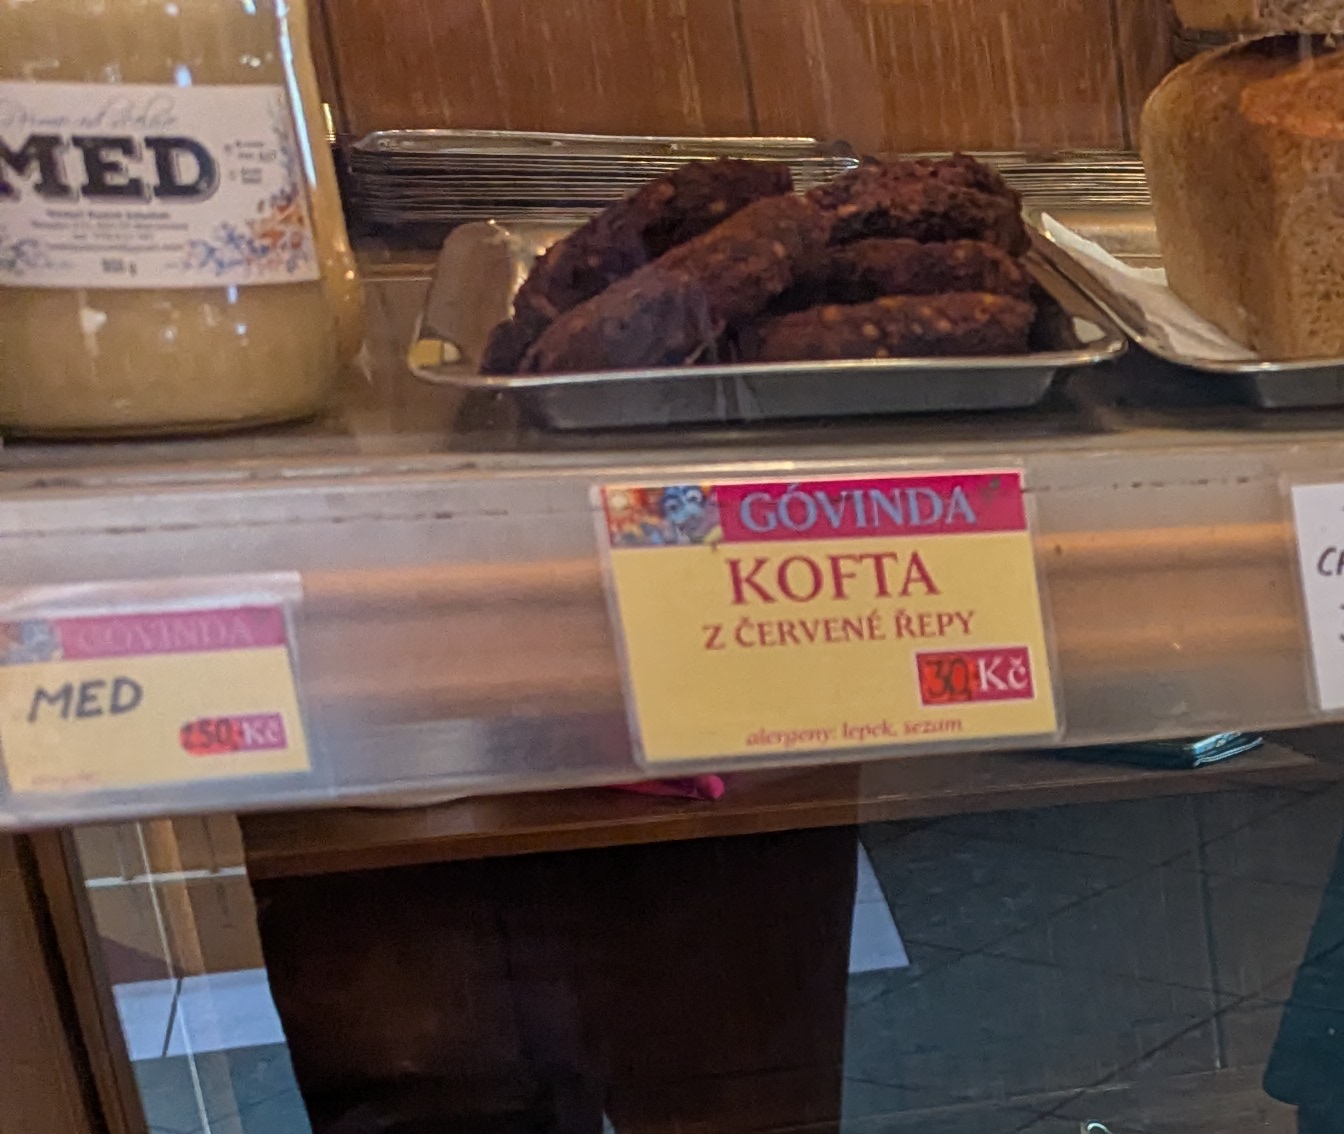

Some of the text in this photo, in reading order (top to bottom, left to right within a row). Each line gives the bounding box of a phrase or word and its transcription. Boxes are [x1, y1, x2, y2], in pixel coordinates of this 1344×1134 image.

[739, 483, 978, 533] GÓVINDA
[725, 550, 941, 606] KOFTA
[703, 607, 976, 651] Z ČERVENÉ ŘEPY
[977, 656, 1028, 692] Kč
[27, 675, 143, 723] MED
